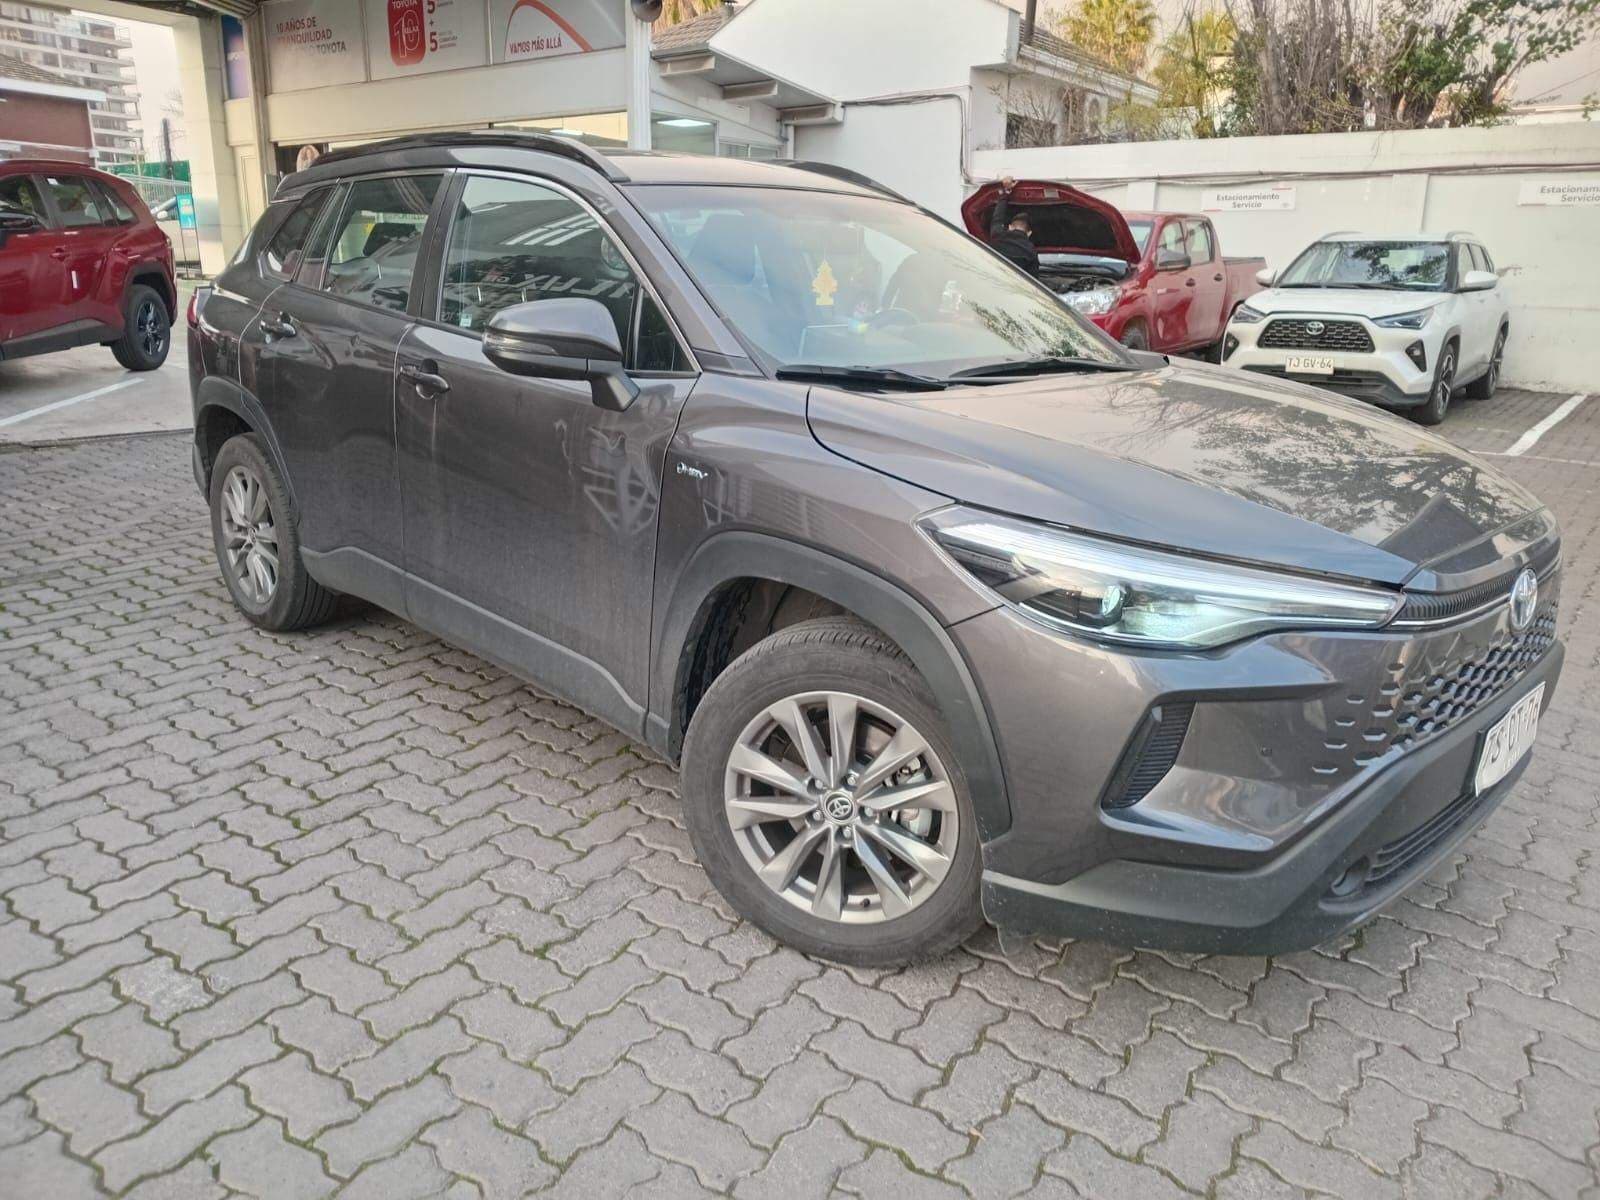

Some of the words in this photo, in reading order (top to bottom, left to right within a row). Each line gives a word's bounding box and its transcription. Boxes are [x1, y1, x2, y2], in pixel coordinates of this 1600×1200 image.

[306, 16, 317, 28] DE
[317, 41, 347, 54] TOYOTA
[430, 32, 438, 52] 5
[510, 41, 530, 54] VAMOS
[1216, 193, 1280, 201] Estacionamiento
[1561, 193, 1600, 202] Servicio
[1232, 201, 1263, 209] Servicio
